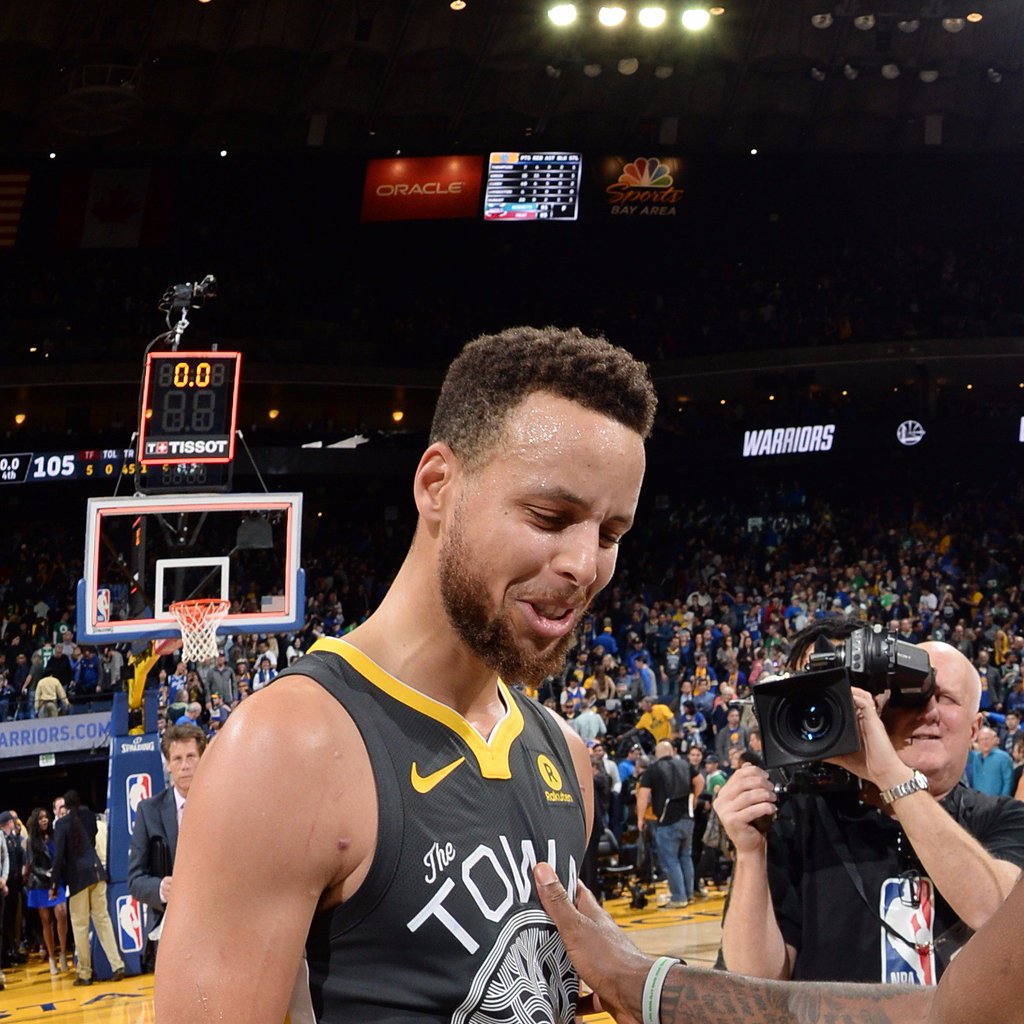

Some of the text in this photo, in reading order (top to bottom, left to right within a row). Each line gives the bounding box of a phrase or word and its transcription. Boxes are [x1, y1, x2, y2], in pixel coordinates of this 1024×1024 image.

[376, 182, 462, 196] ORACLE
[606, 182, 684, 205] Sports
[611, 205, 676, 215] BAY AREA
[174, 362, 211, 387] 0.0
[169, 440, 228, 454] TISSOT
[743, 424, 835, 457] WARRIORS
[85, 450, 95, 459] TF
[103, 449, 118, 459] TOL
[33, 455, 75, 478] 105
[86, 464, 94, 476] 5
[105, 463, 113, 475] 0
[2, 471, 16, 481] 4th
[121, 741, 155, 753] SPALDING
[544, 790, 574, 803] Rakuten
[423, 841, 456, 884] The
